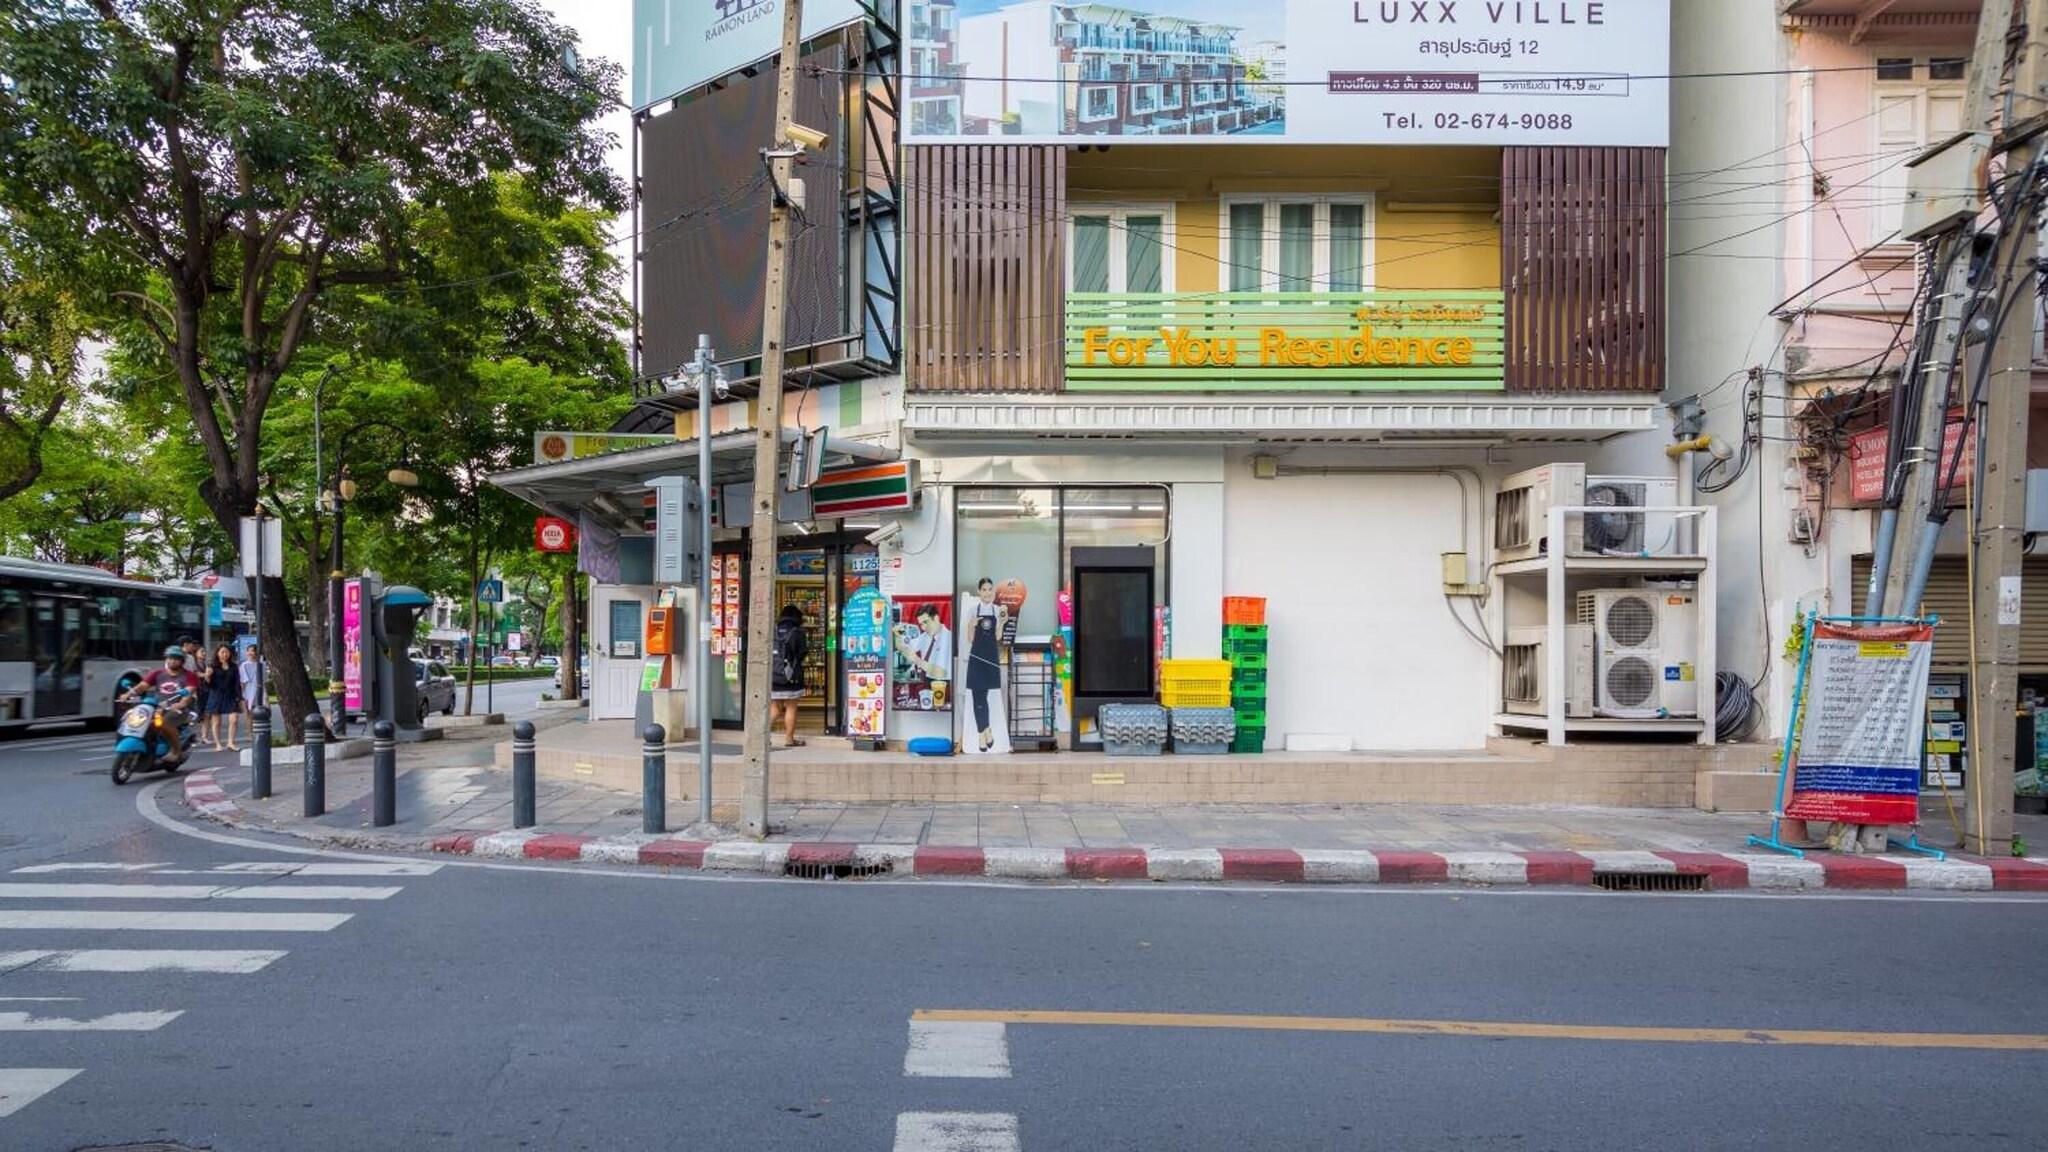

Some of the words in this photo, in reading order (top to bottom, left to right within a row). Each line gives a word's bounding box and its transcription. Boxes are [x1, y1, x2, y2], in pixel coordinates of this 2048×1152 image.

[704, 13, 745, 43] RAIMON
[747, 1, 775, 23] LAND
[1353, 1, 1457, 24] LUXX
[1486, 1, 1604, 25] VILLE
[1419, 38, 1512, 58] สาธุประดิษฐ์
[1518, 40, 1539, 55] 12
[1555, 77, 1585, 91] 14.9
[1382, 112, 1424, 129] Tel.
[1434, 112, 1573, 130] 02-674-9088
[1082, 326, 1152, 367] For
[1159, 327, 1236, 366] You
[1259, 324, 1474, 367] Residence
